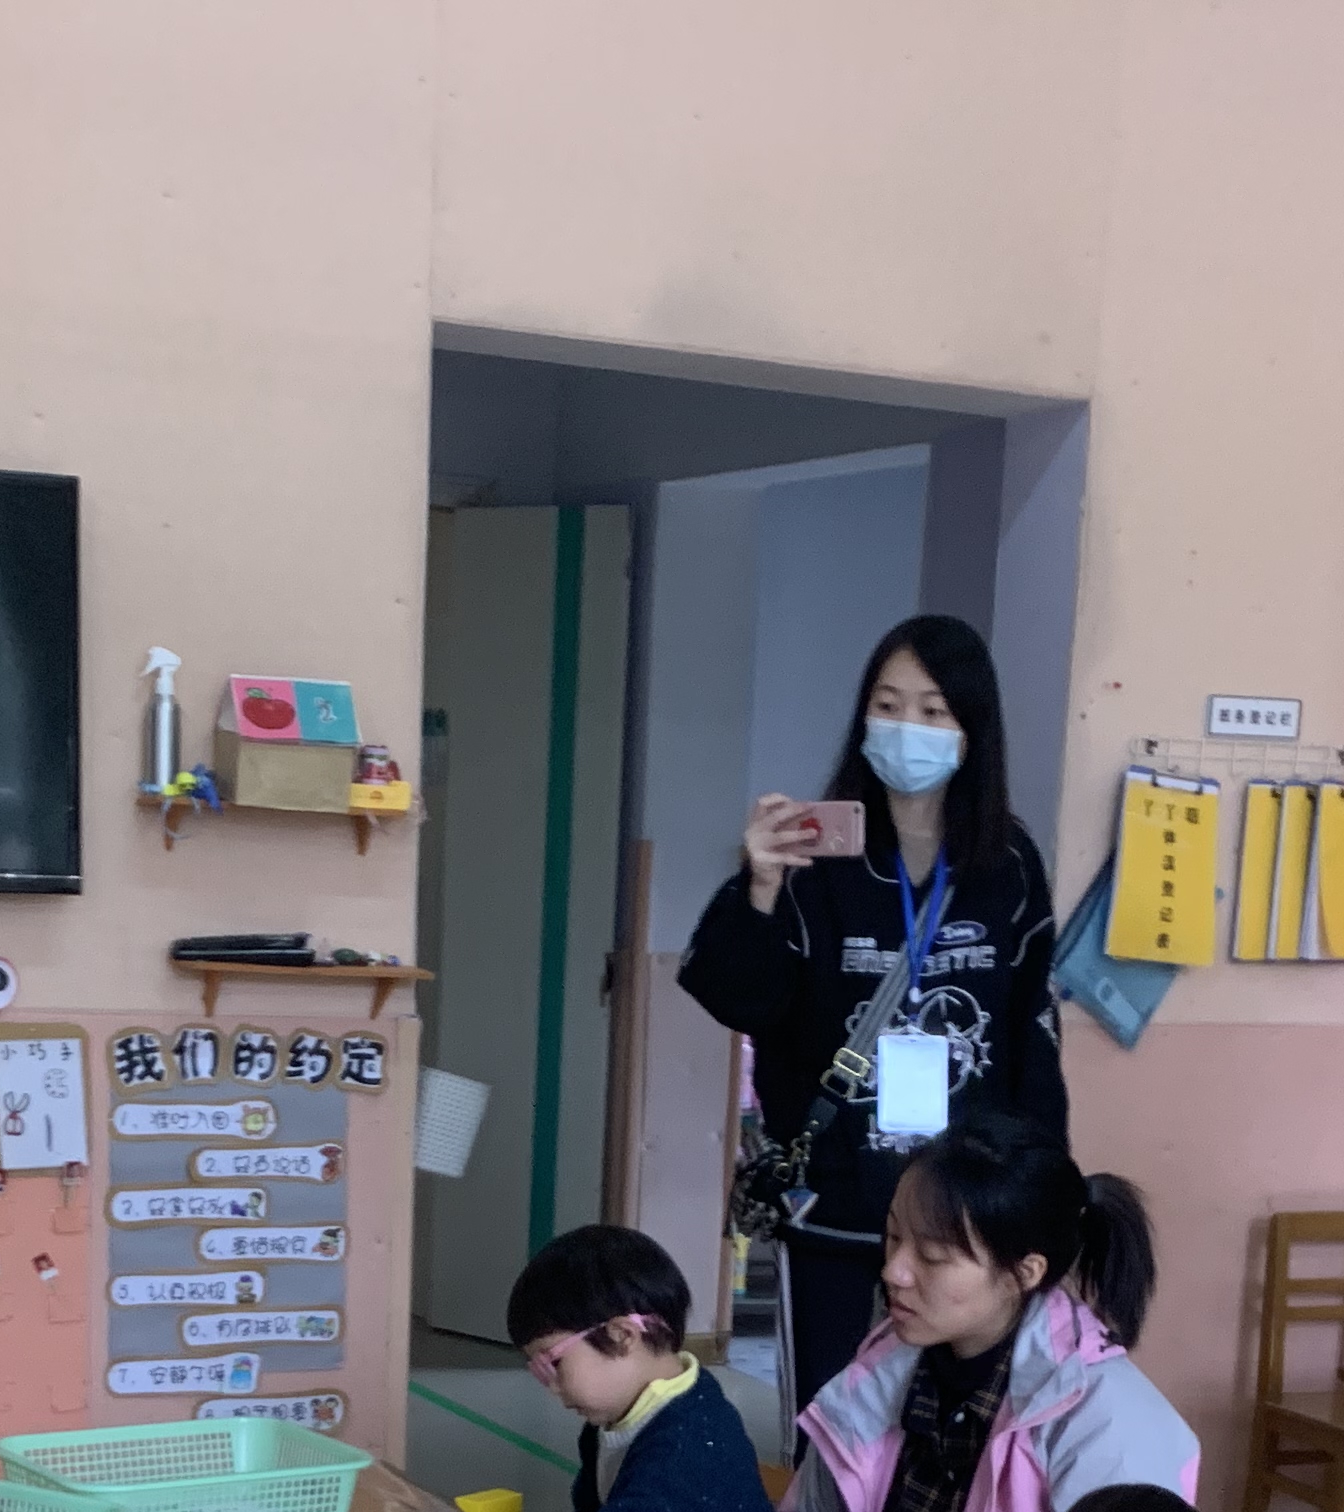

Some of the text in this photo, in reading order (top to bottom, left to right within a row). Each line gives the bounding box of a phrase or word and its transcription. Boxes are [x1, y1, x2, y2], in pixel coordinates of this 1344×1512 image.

[114, 1028, 385, 1087] 我们的约定
